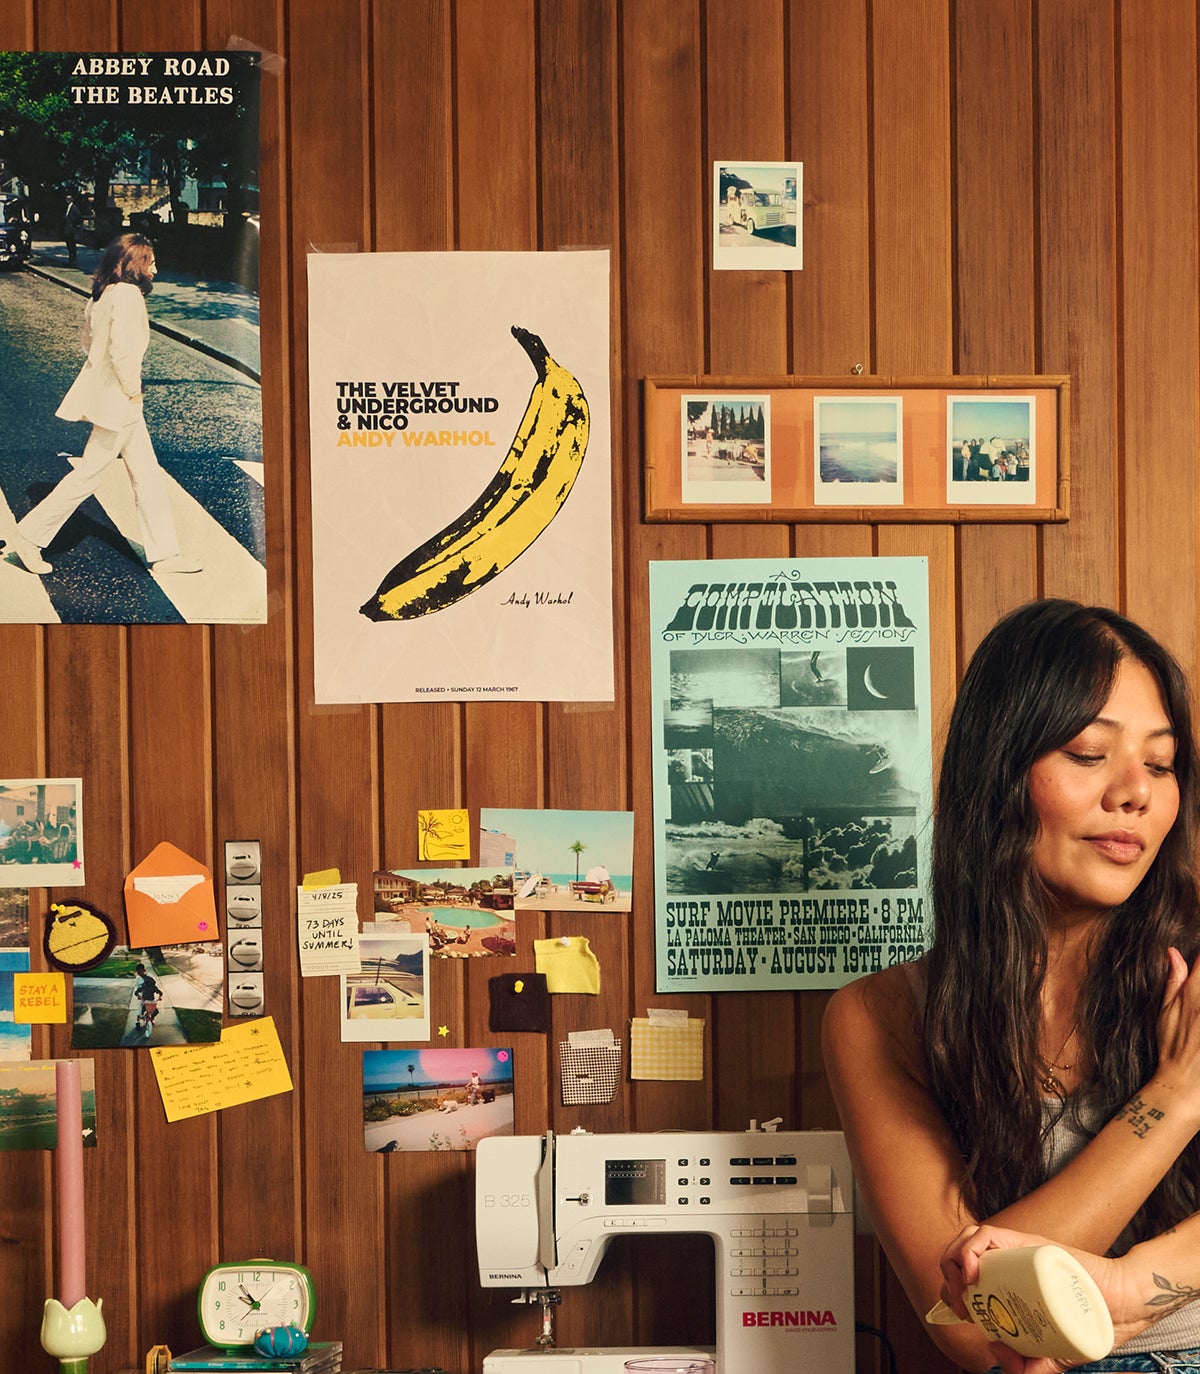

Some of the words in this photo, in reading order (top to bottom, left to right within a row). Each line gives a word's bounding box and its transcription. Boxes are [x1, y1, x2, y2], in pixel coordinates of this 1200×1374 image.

[71, 58, 154, 76] ABBEY
[163, 58, 231, 76] ROAD
[71, 86, 120, 104] THE
[127, 86, 234, 105] BEATLES
[335, 382, 377, 398] THE
[382, 382, 460, 398] VELVET
[336, 397, 499, 414] UNDERGROUND
[336, 414, 351, 431] &
[357, 414, 409, 431] NICO
[336, 431, 396, 448] ANDY
[401, 430, 496, 447] WARHOL
[500, 591, 531, 609] Andy
[535, 591, 574, 605] Warhol
[662, 632, 685, 642] OF
[691, 632, 745, 646] TYLER
[748, 630, 830, 645] WARREN
[836, 628, 917, 643] SESSIONS
[666, 901, 711, 928] SURF
[716, 900, 774, 927] MOVIE
[779, 899, 870, 926] PREMIERE
[880, 898, 891, 925] 8
[898, 898, 924, 925] PM
[305, 919, 320, 930] 73
[322, 917, 345, 929] DAYS
[312, 930, 344, 940] UNTIL
[667, 929, 682, 947] LA
[685, 928, 732, 947] PALOMA
[734, 927, 787, 946] THEATER
[793, 926, 817, 946] SAN
[819, 925, 851, 945] DIEGO
[857, 924, 925, 945] CALIFORNIA
[302, 937, 354, 950] SUMMER!
[667, 947, 759, 976] SATURDAY
[770, 946, 838, 974] AUGUST
[843, 945, 882, 973] 19TH
[19, 984, 48, 995] STAY
[49, 983, 59, 995] A
[19, 996, 60, 1008] REBEL
[484, 1195, 496, 1208] B
[500, 1194, 531, 1208] 325
[238, 1272, 244, 1283] 11
[253, 1271, 261, 1282] 12
[218, 1281, 227, 1292] 10
[289, 1280, 295, 1291] 2
[215, 1300, 221, 1311] 9
[293, 1299, 299, 1310] 3
[742, 1310, 837, 1327] BERNINA
[219, 1320, 225, 1331] 8
[238, 1328, 243, 1339] 7
